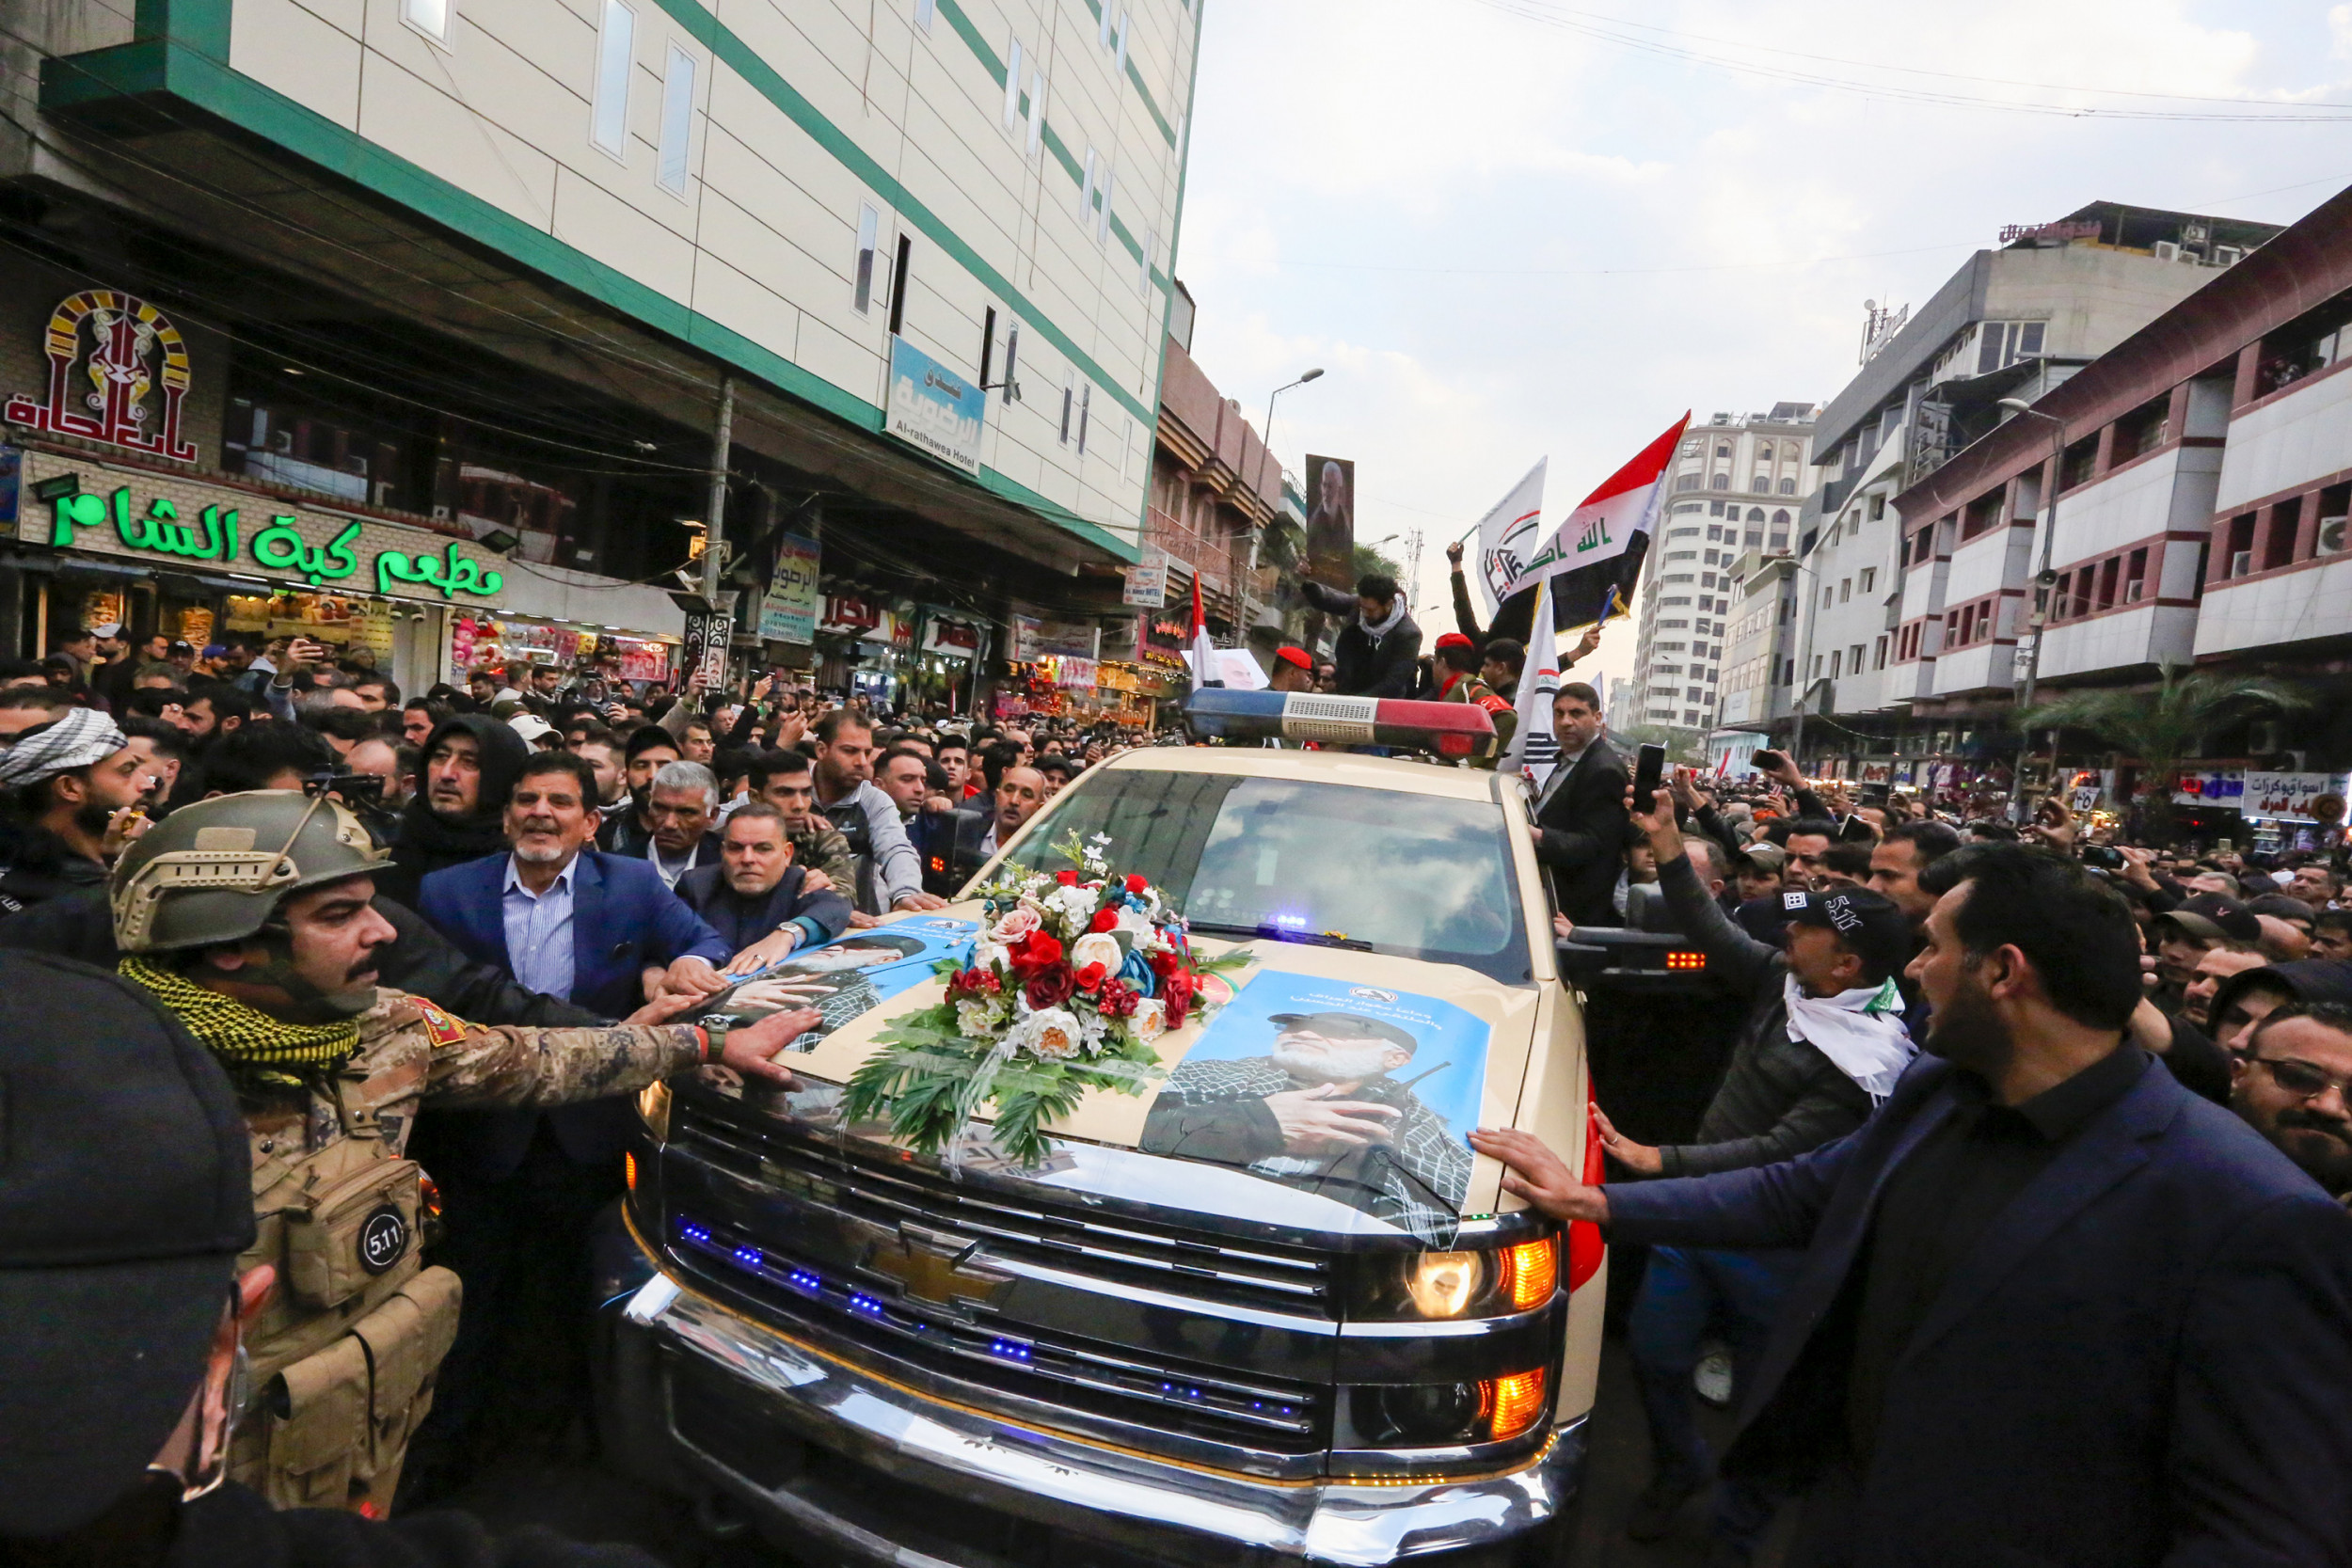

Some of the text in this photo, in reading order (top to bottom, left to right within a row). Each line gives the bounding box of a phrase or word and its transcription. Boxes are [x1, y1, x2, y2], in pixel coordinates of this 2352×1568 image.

[923, 360, 962, 402] فندق
[894, 374, 979, 448] الرضوية
[896, 420, 975, 468] Al-rathawea Hotel
[50, 484, 504, 599] مطعم كبة الشام
[1576, 516, 1613, 553] الله
[771, 562, 818, 594] الرضوي
[1825, 895, 1863, 931] 5.11
[370, 1225, 399, 1256] 5.11
